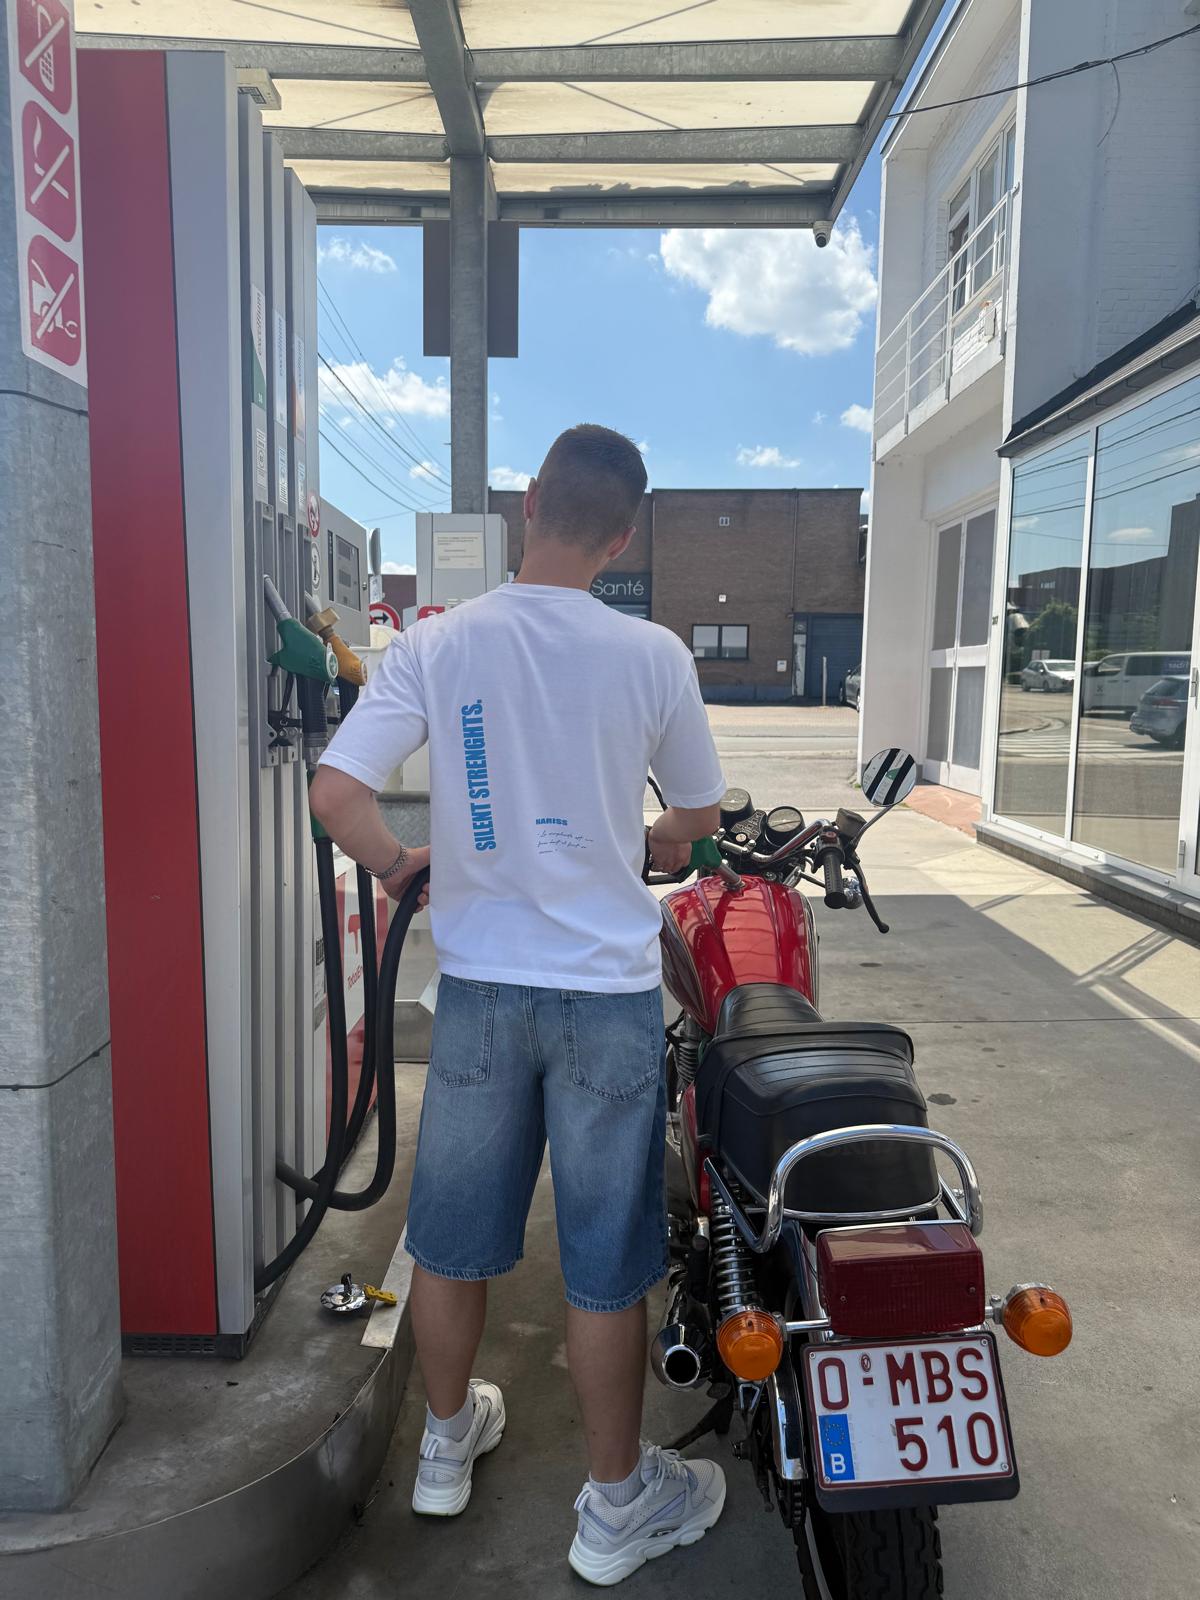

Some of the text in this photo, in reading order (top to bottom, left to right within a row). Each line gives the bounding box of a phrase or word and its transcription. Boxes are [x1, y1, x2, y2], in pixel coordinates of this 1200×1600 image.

[591, 578, 645, 596] Santé
[461, 698, 497, 851] SILENT STRENGHTS.
[895, 1411, 999, 1472] 510
[830, 1453, 846, 1474] B
